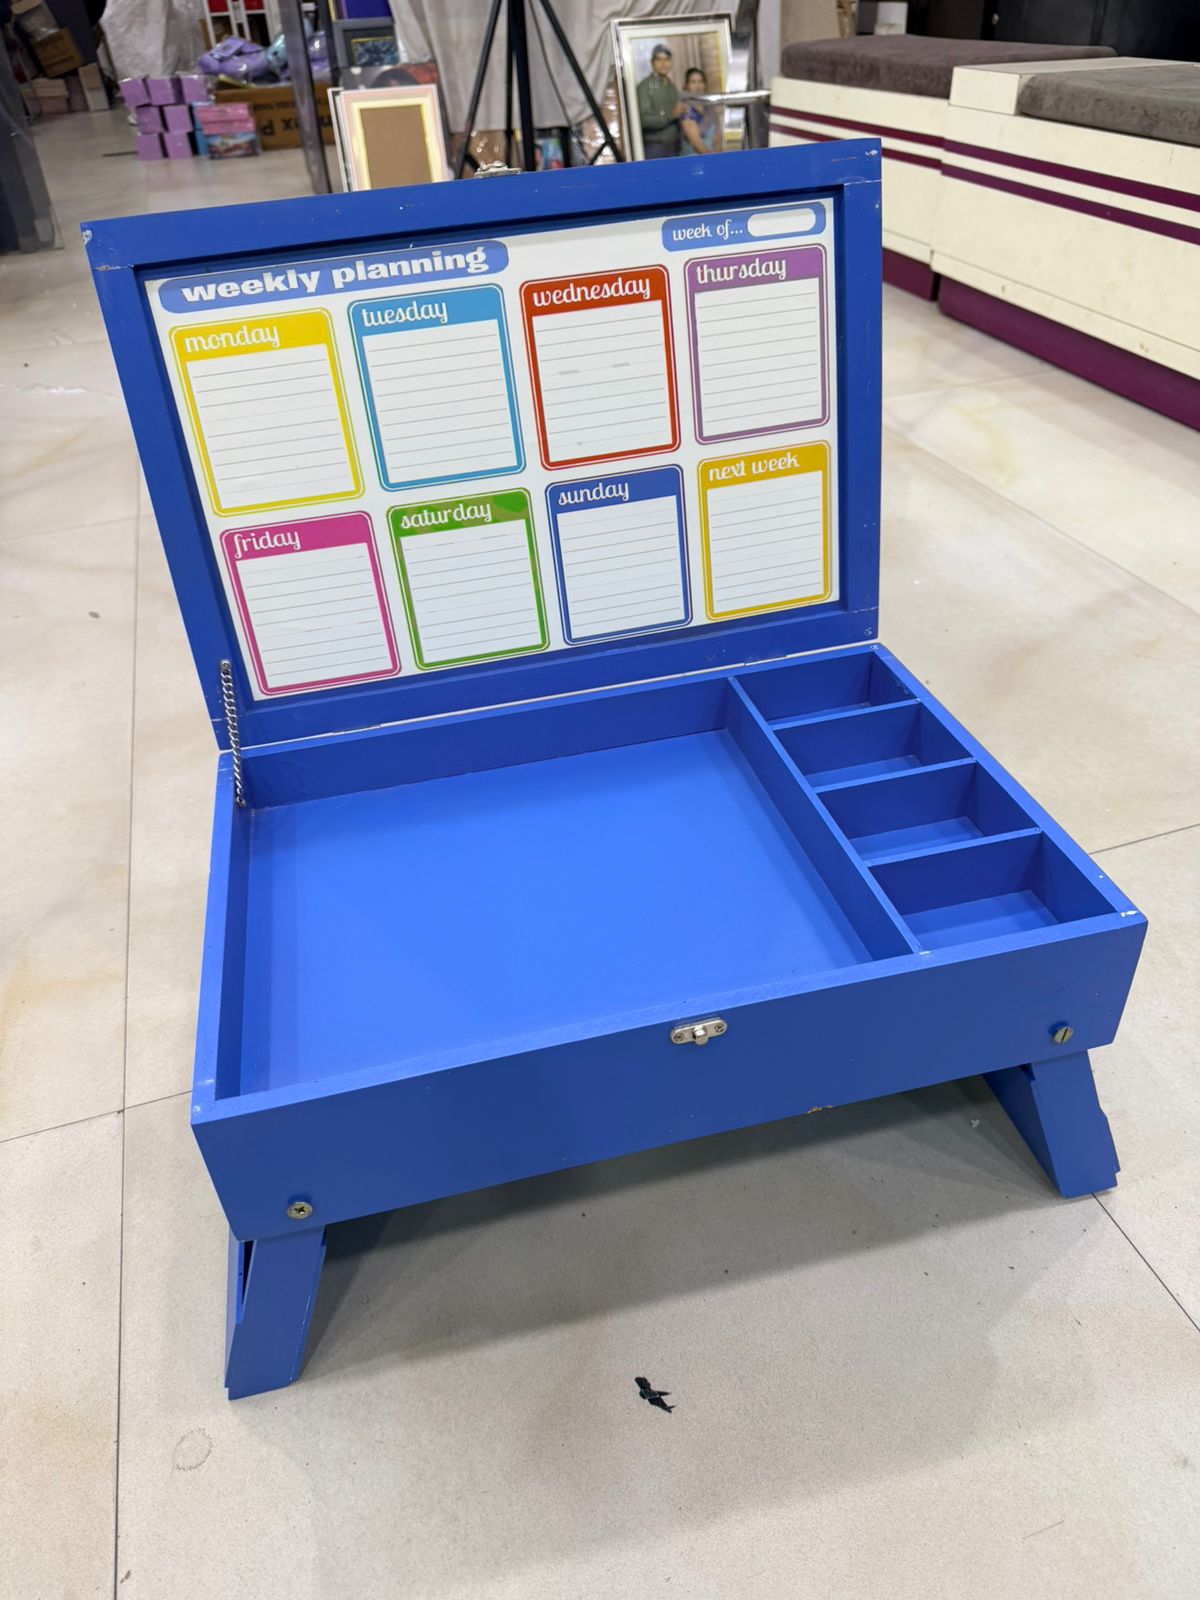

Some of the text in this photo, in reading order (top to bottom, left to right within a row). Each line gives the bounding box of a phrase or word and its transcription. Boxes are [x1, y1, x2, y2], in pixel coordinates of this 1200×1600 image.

[672, 219, 743, 242] week of...
[181, 246, 490, 303] weekly planning
[695, 256, 787, 285] thursday
[533, 276, 651, 307] wednesday
[362, 300, 448, 327] tuesday
[184, 322, 280, 353] monday
[708, 451, 800, 482] next week
[558, 480, 630, 506] sunday
[400, 501, 492, 529] saturday
[233, 527, 302, 559] friday
